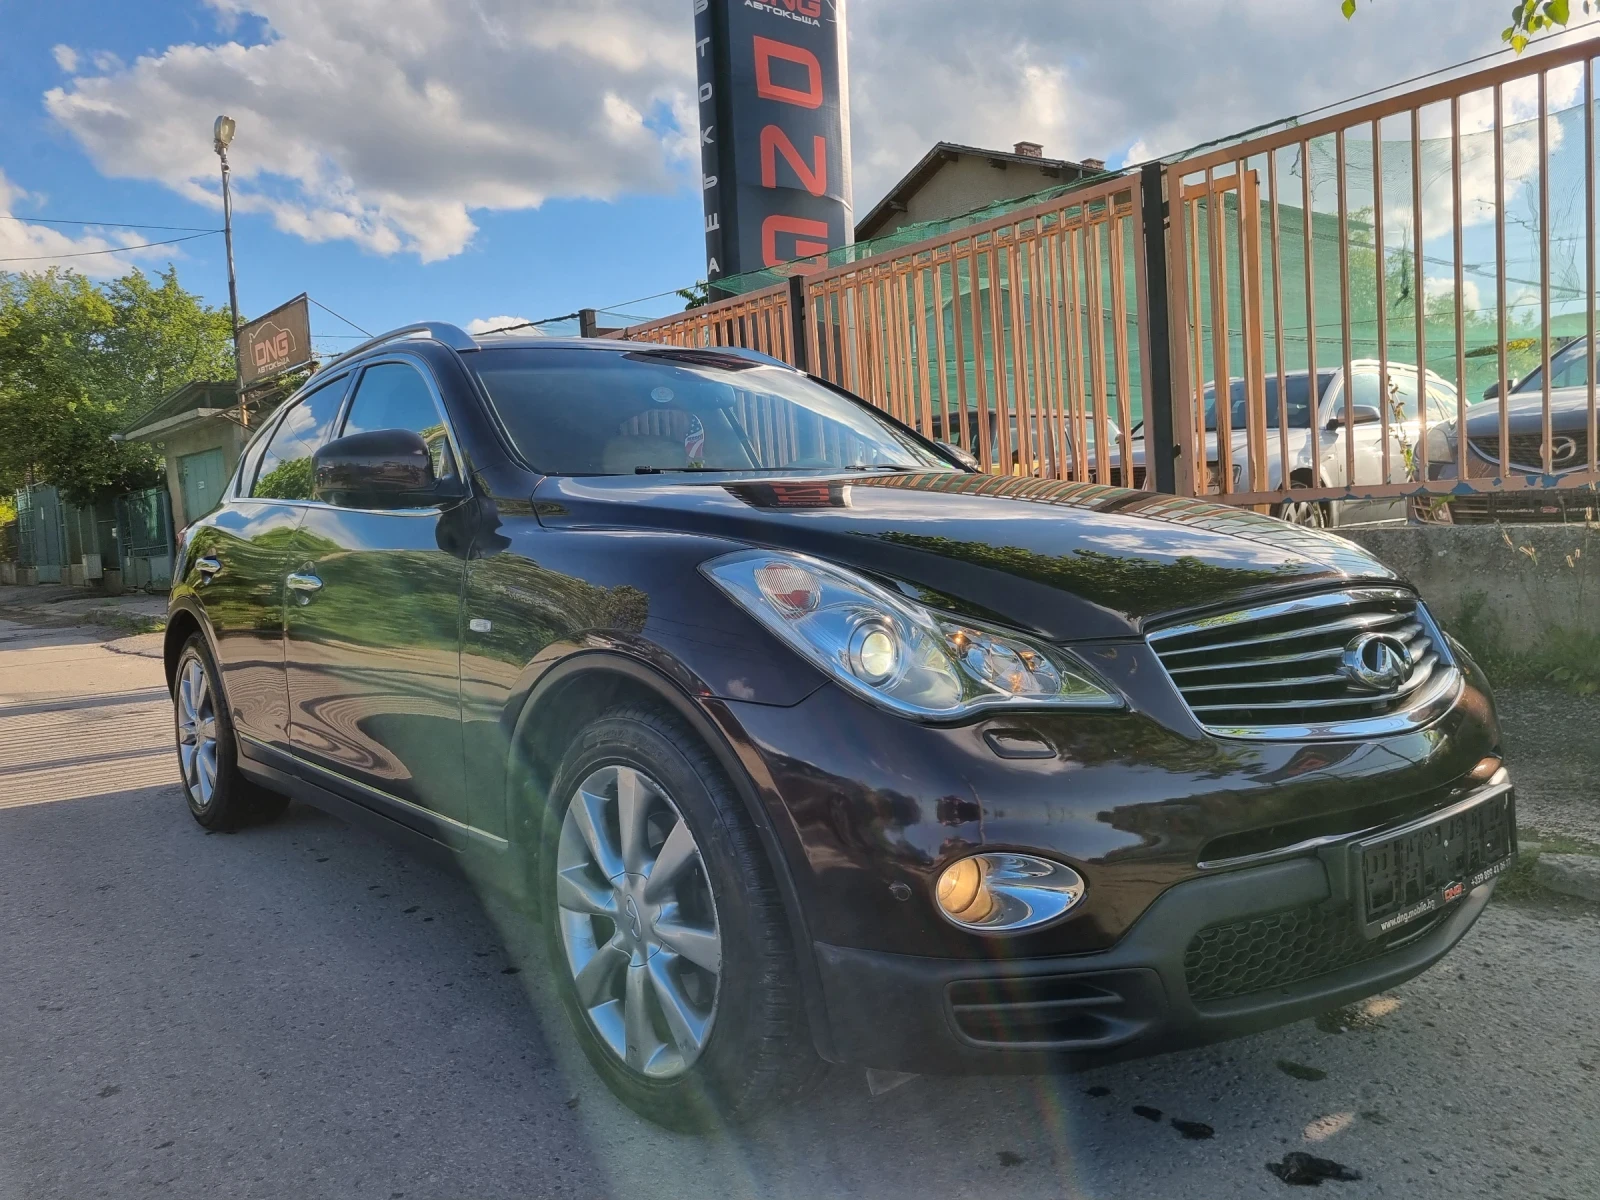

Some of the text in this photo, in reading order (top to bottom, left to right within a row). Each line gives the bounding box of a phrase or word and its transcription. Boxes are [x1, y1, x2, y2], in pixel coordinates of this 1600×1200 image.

[753, 35, 829, 276] DNG
[255, 331, 289, 366] DNG
[1380, 899, 1435, 931] www.dng.mobile.bg
